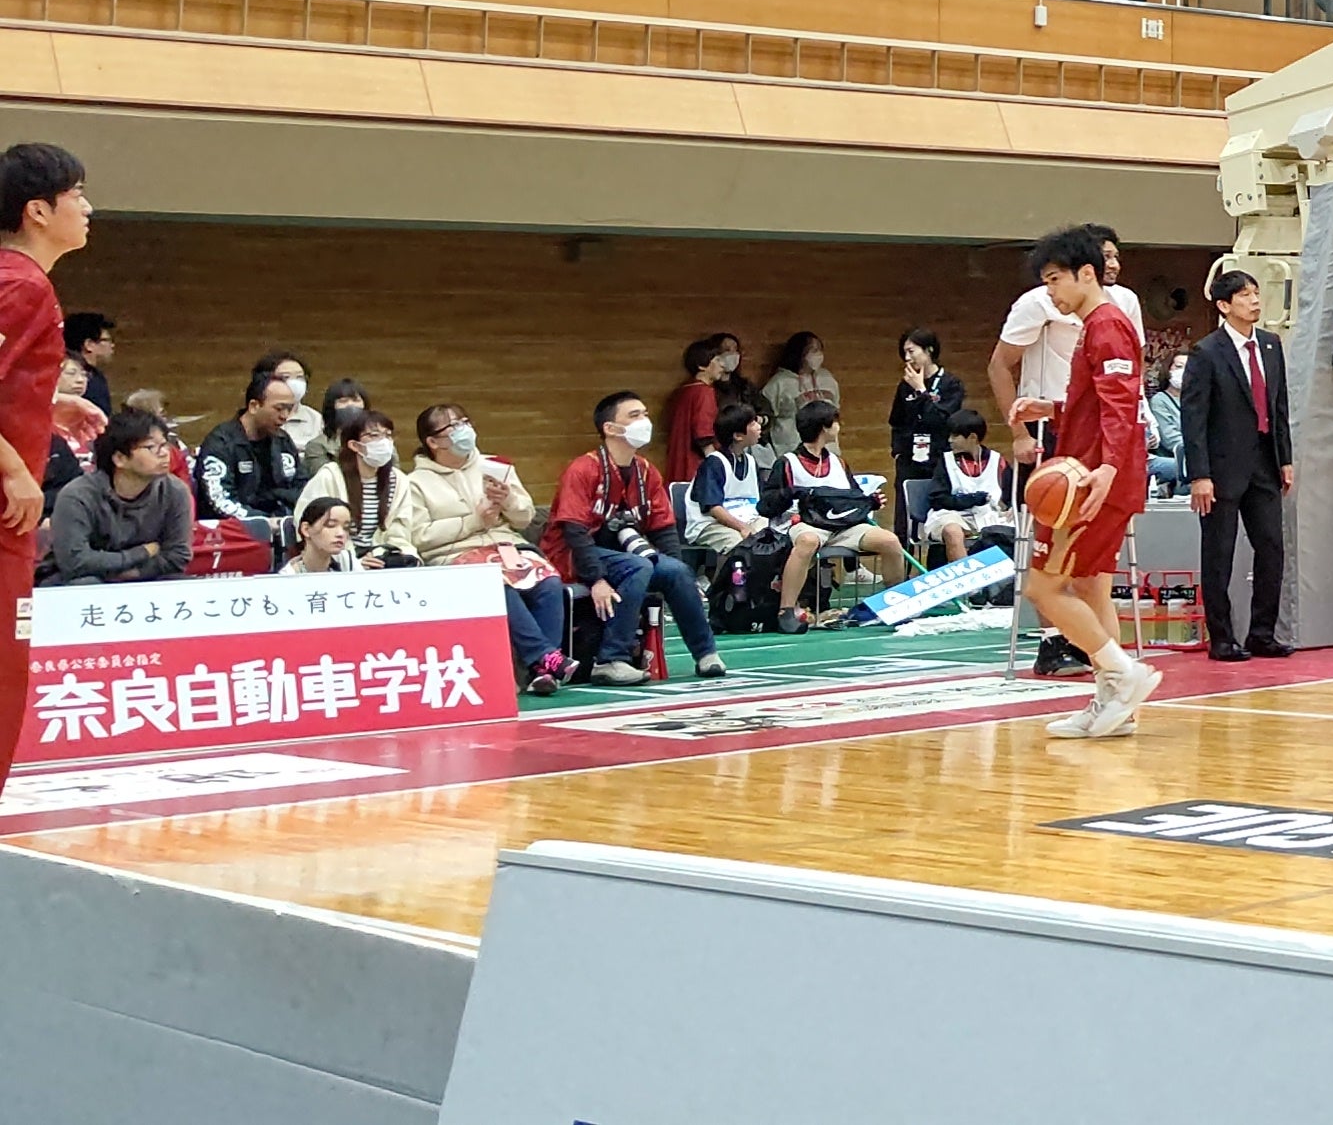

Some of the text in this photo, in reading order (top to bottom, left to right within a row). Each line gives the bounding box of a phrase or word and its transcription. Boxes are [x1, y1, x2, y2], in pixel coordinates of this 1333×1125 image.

[912, 558, 986, 593] ASUKA
[80, 589, 428, 628] 走るよろこびも、育てたい。
[29, 652, 162, 673] 奈良県公安委員会指定
[33, 644, 484, 743] 奈良自動車学校
